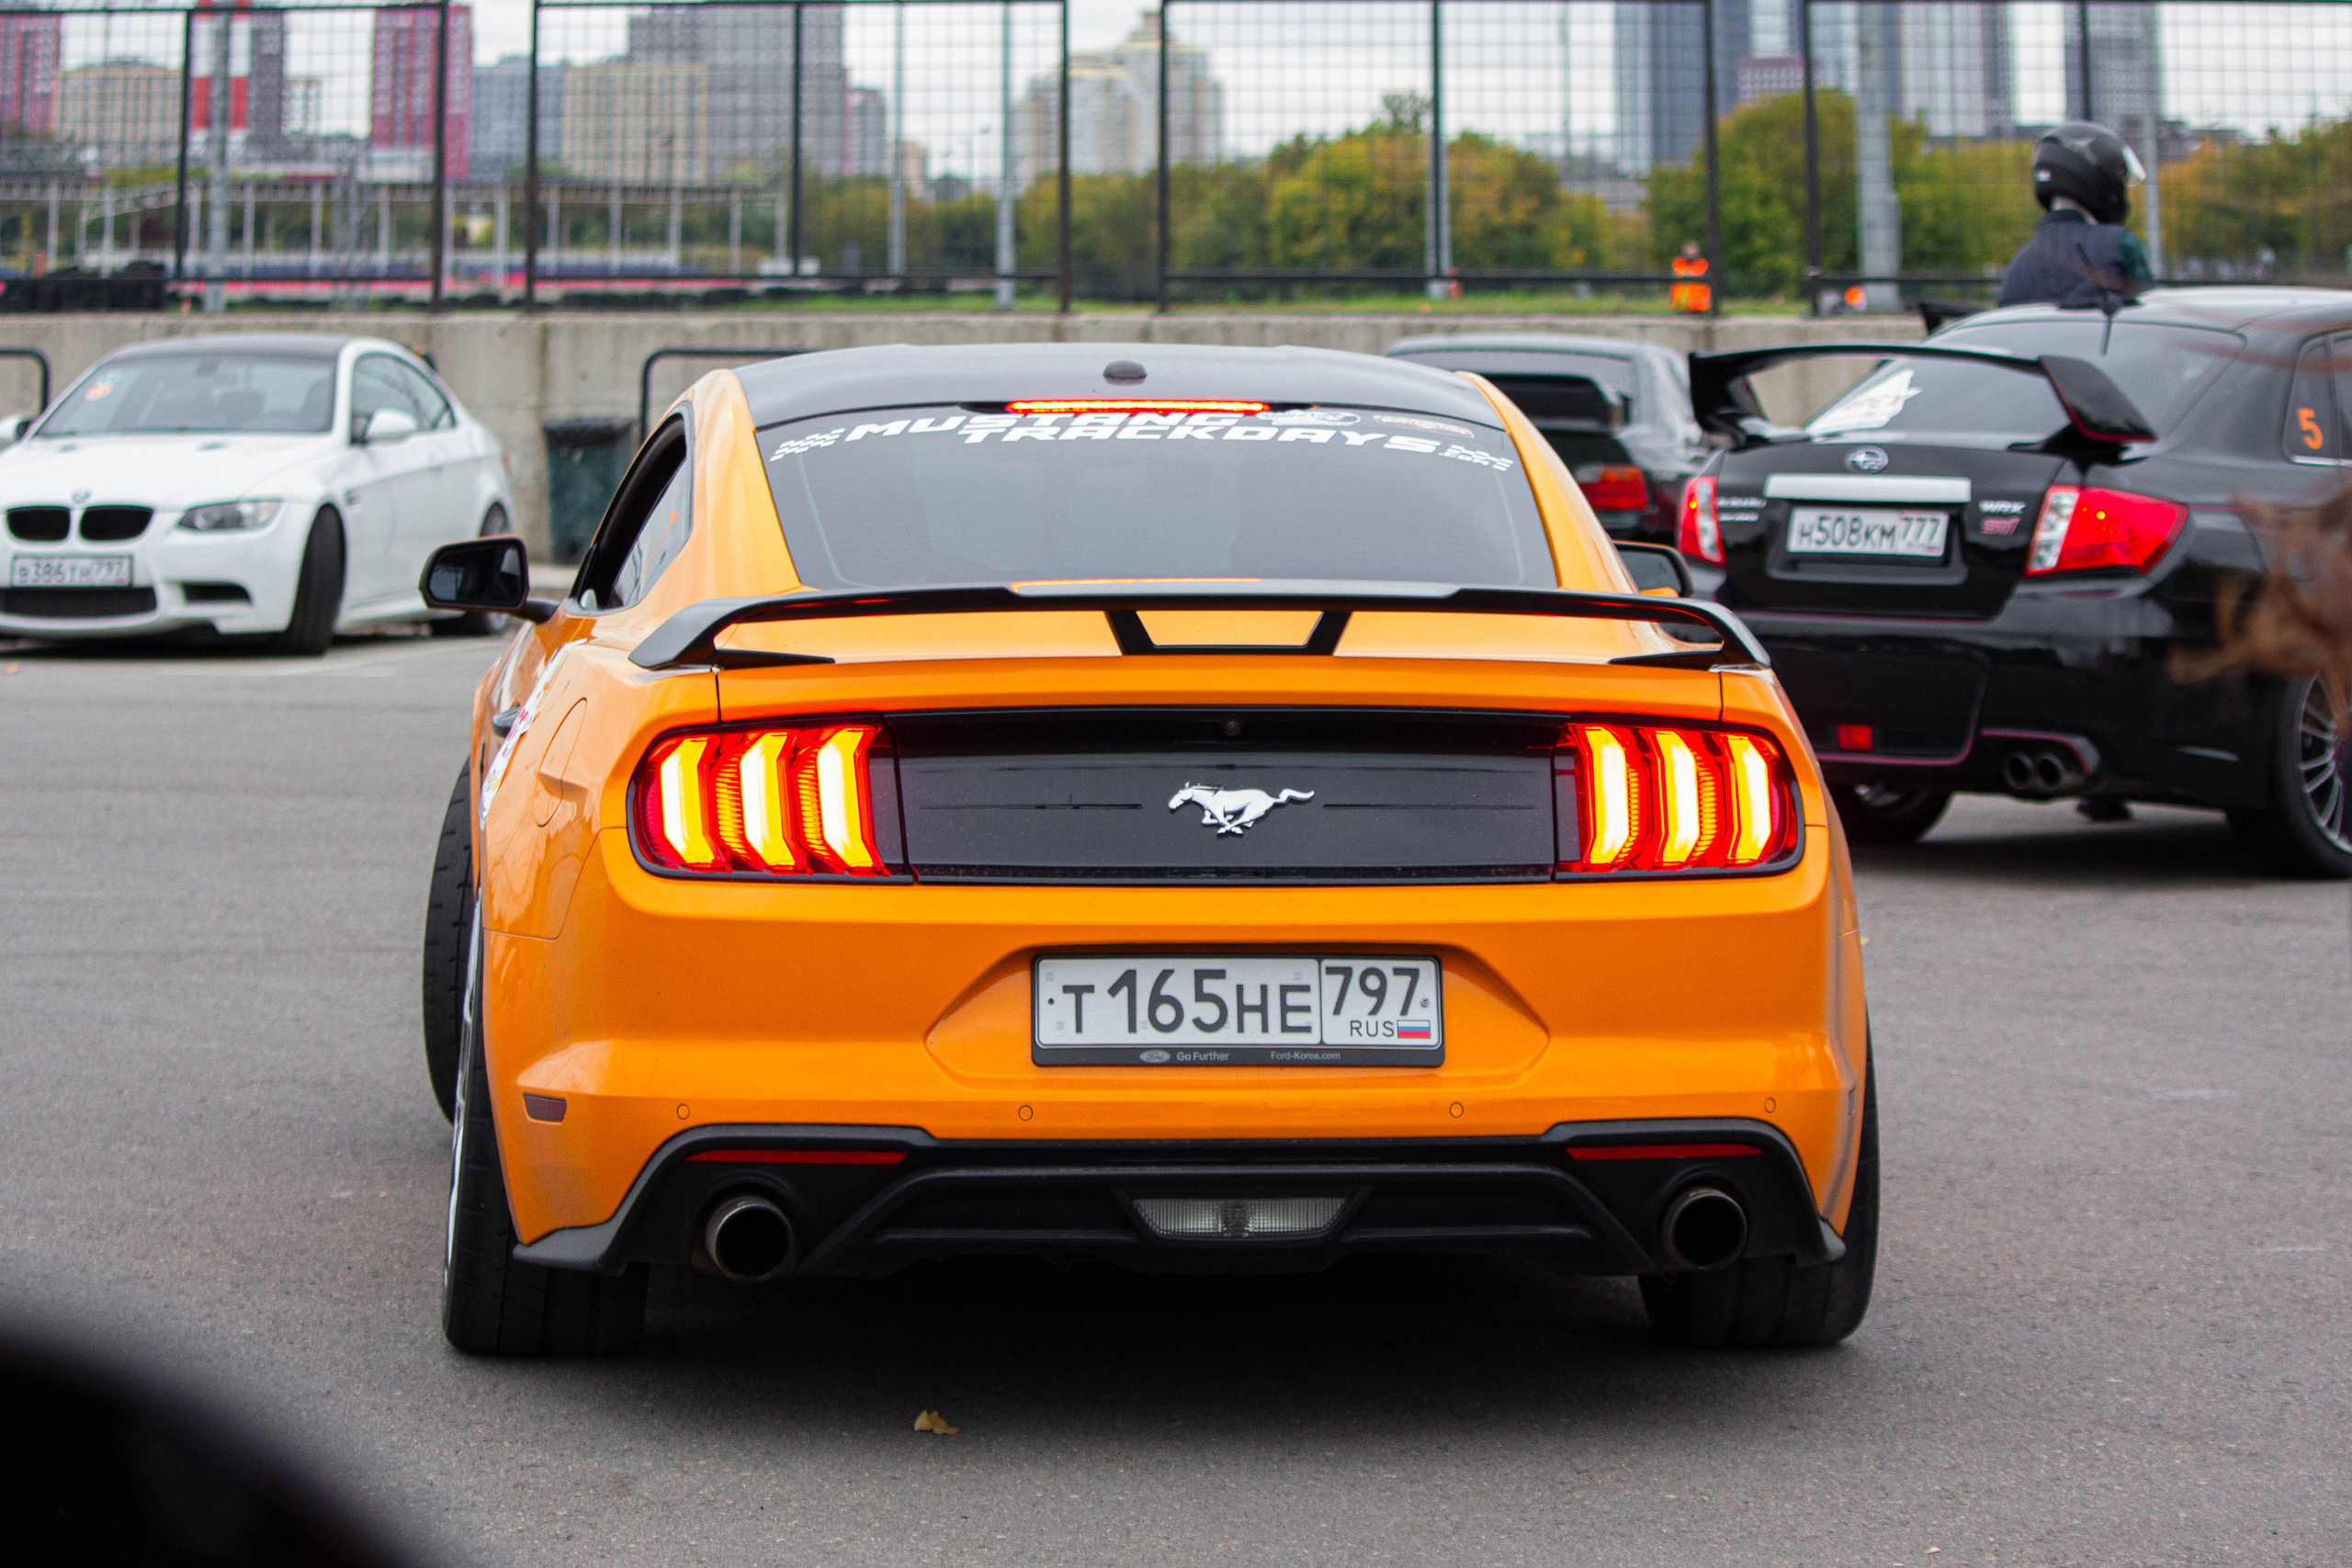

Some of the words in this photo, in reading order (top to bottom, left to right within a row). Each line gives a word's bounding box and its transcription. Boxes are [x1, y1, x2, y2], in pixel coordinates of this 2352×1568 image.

[844, 412, 1245, 442] MUSTANG
[958, 425, 1442, 454] TRACKDAYS
[2298, 408, 2324, 450] 5
[1901, 516, 1940, 542] 777
[1062, 969, 1313, 1034] T165HE
[1326, 966, 1420, 1017] 797
[1350, 1020, 1395, 1037] RUS
[1176, 1051, 1192, 1062] Go
[1193, 1050, 1230, 1062] Further
[1270, 1050, 1341, 1061] Ford-Korea.com
